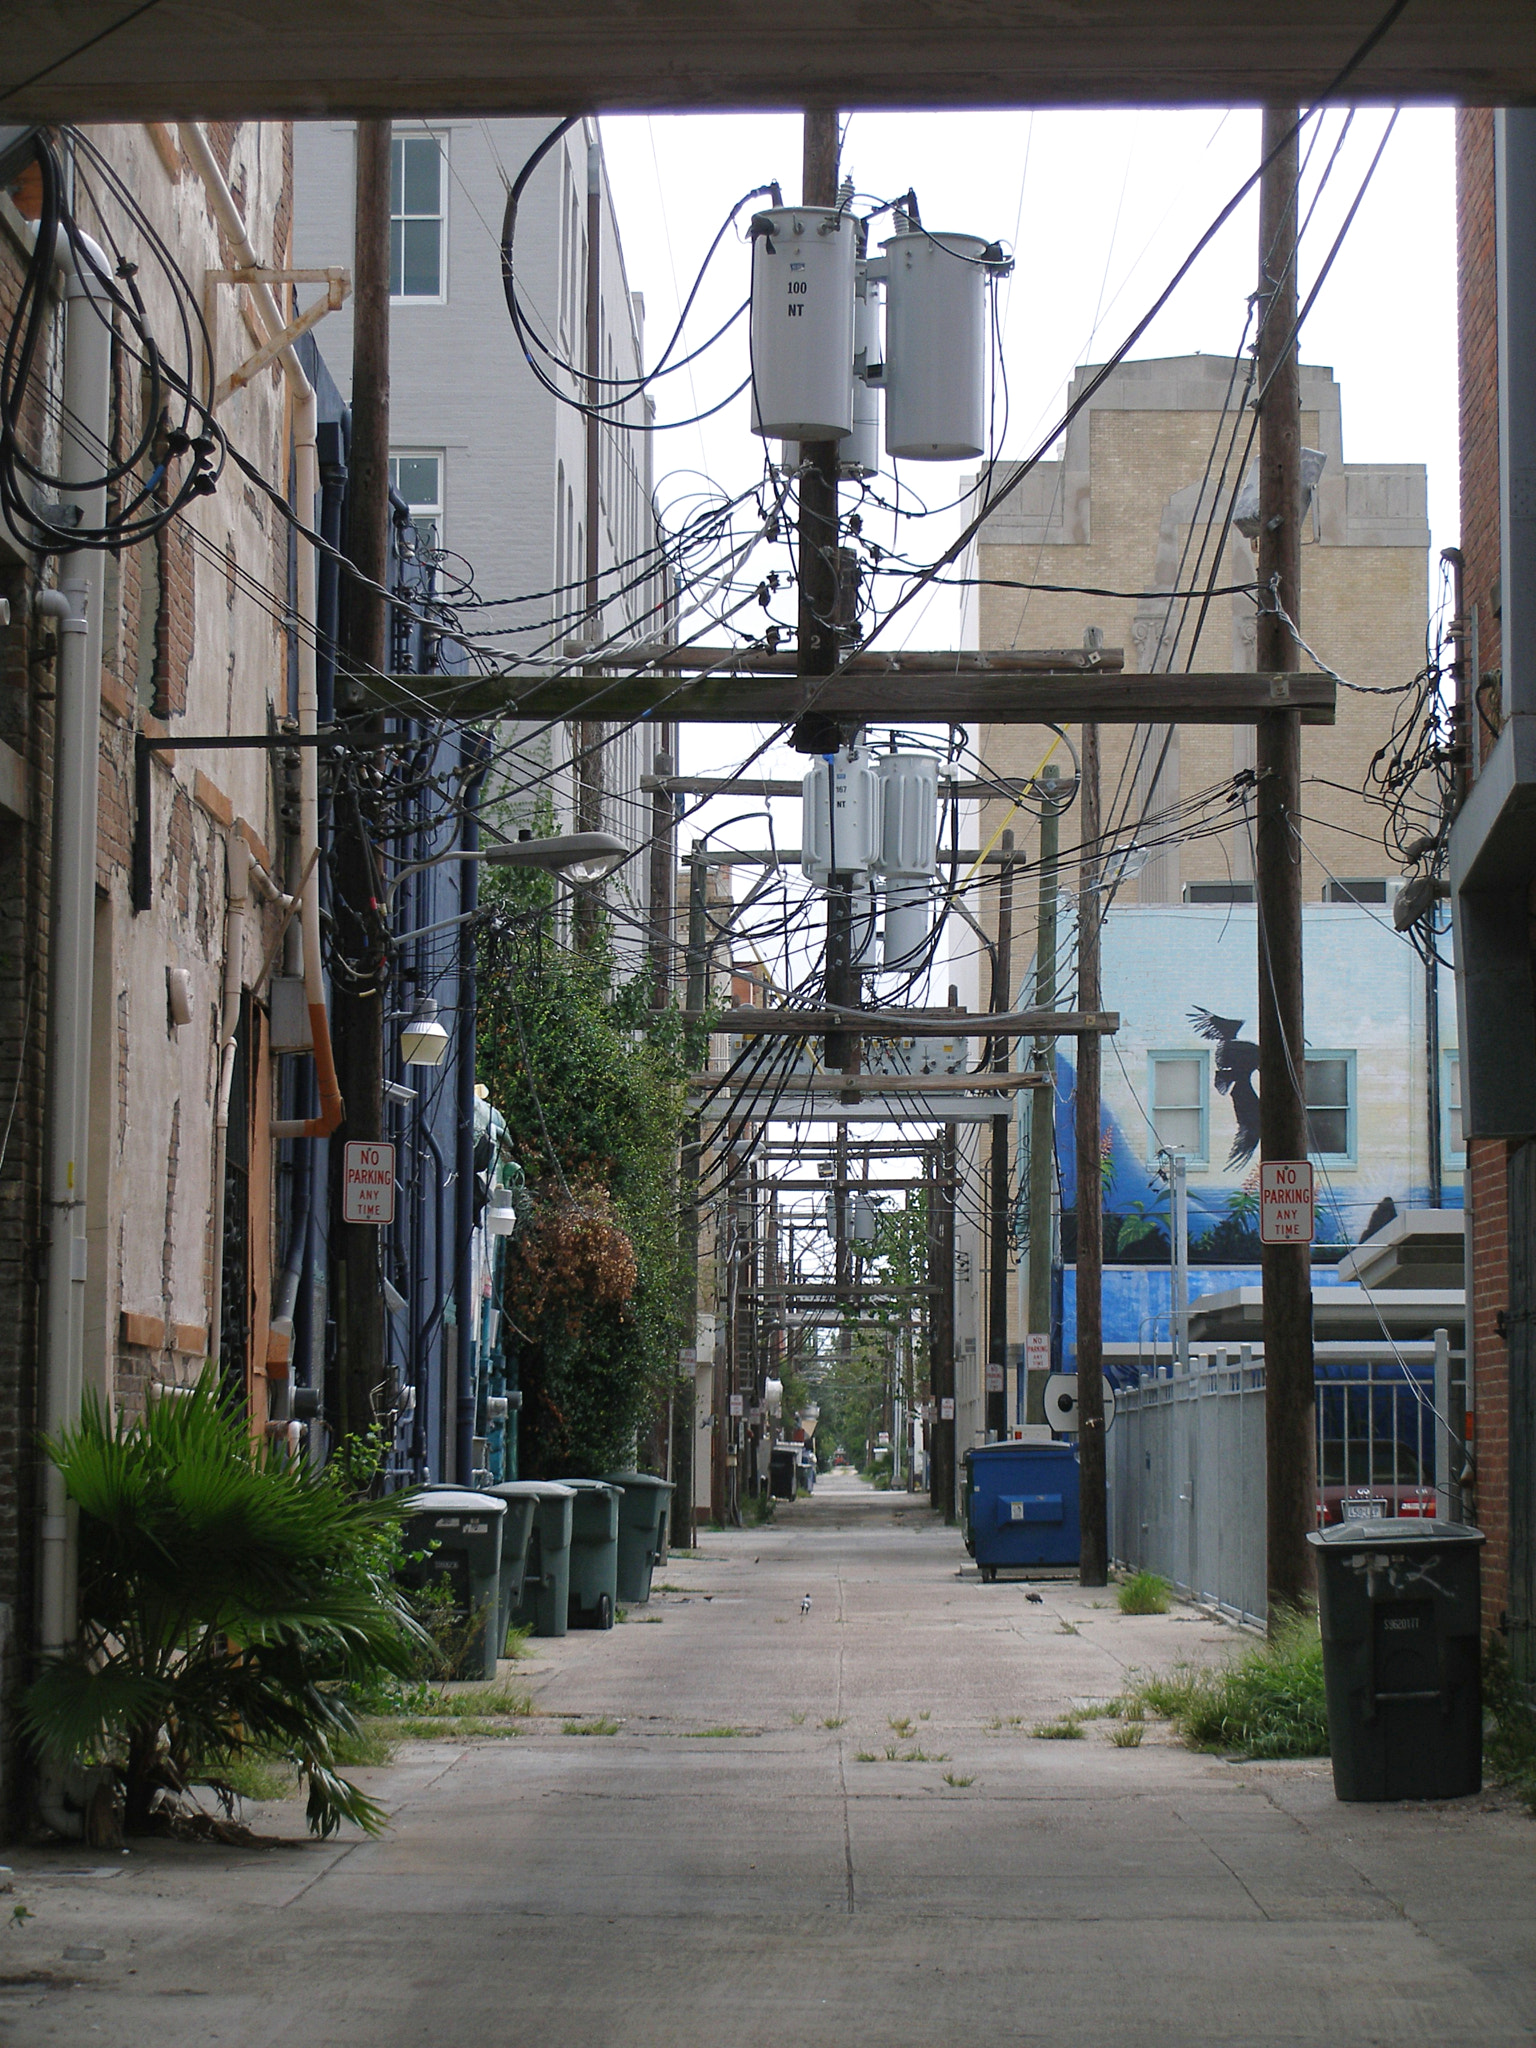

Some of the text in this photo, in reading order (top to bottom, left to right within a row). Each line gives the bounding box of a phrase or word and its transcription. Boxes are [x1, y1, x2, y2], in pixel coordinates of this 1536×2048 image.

[787, 281, 807, 294] 100
[788, 303, 805, 317] NT
[836, 785, 848, 794] 167
[836, 800, 846, 809] NT
[360, 1150, 379, 1166] NO
[347, 1168, 391, 1186] PARKING
[1276, 1169, 1297, 1185] NO
[359, 1189, 380, 1201] ANY
[1263, 1188, 1310, 1204] PARKING
[357, 1204, 381, 1216] TIME
[1276, 1209, 1298, 1220] ANY
[1274, 1224, 1300, 1235] TIME
[1032, 1336, 1043, 1344] NO
